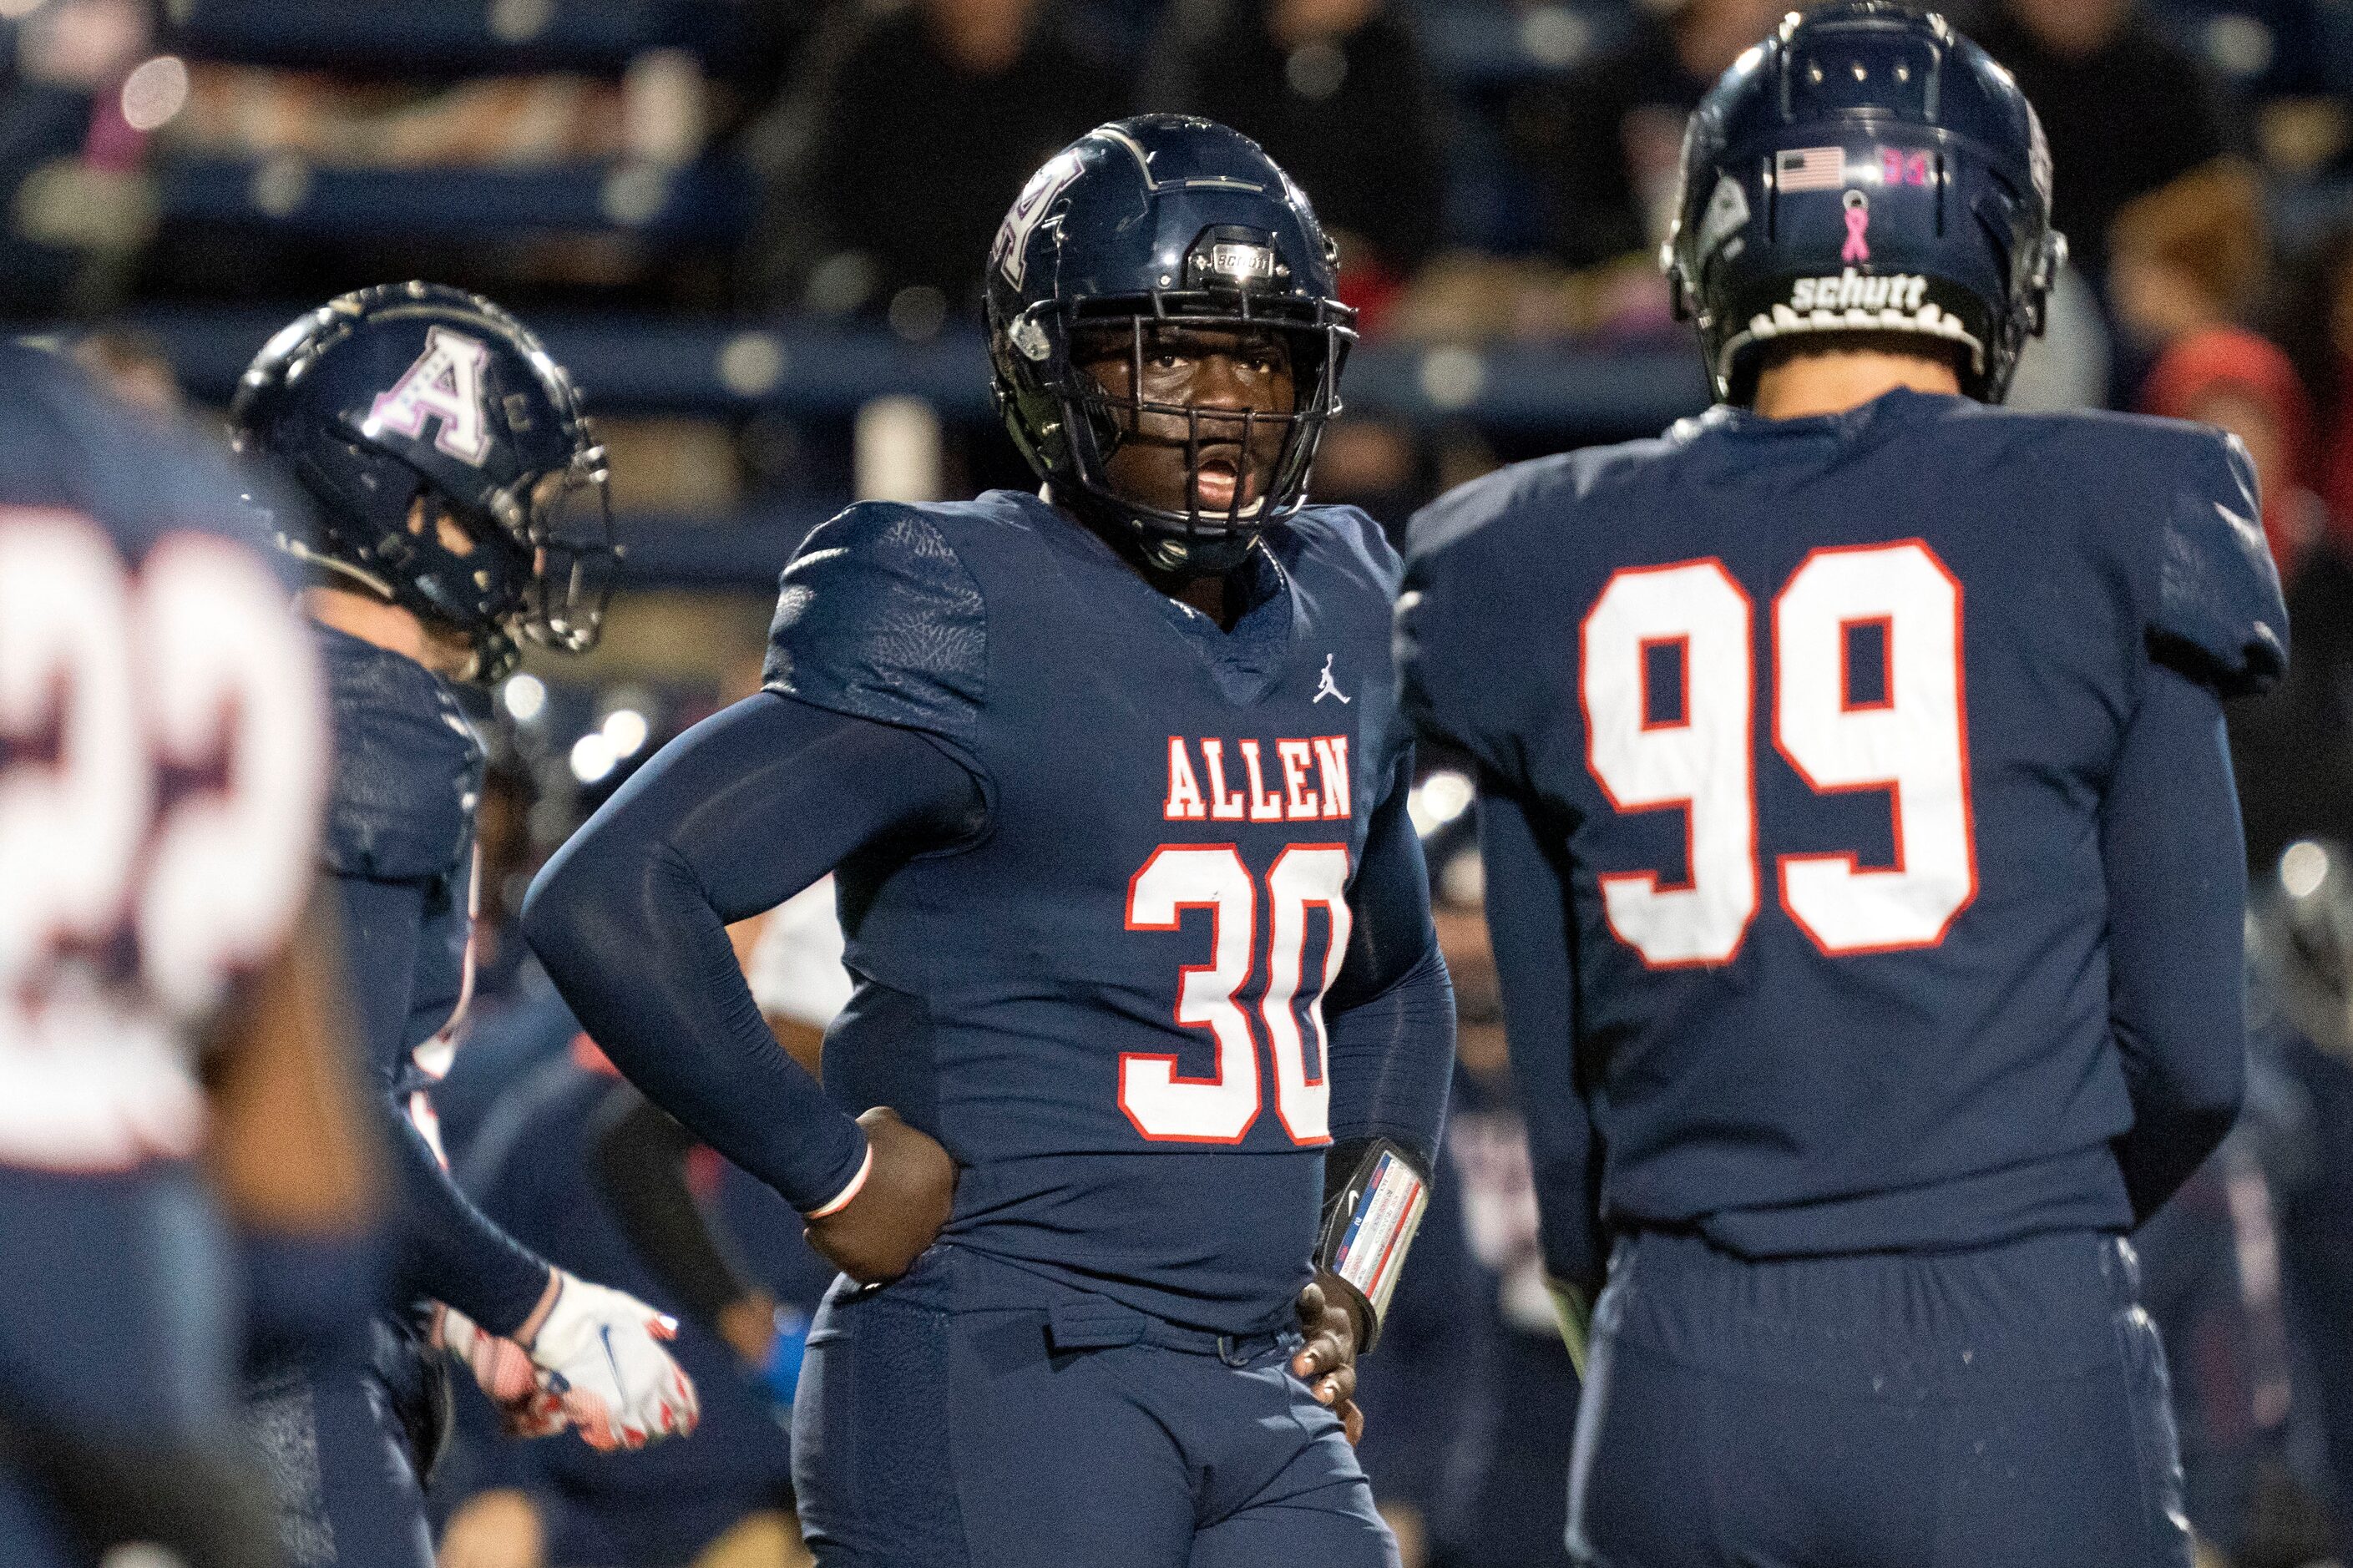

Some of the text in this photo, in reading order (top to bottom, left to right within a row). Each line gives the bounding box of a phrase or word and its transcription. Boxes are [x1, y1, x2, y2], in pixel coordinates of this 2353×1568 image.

[1791, 268, 1926, 310] schutt
[366, 326, 493, 468] A
[1164, 736, 1351, 822] ALLEN
[1579, 538, 1979, 970] 99
[1119, 843, 1352, 1145] 30
